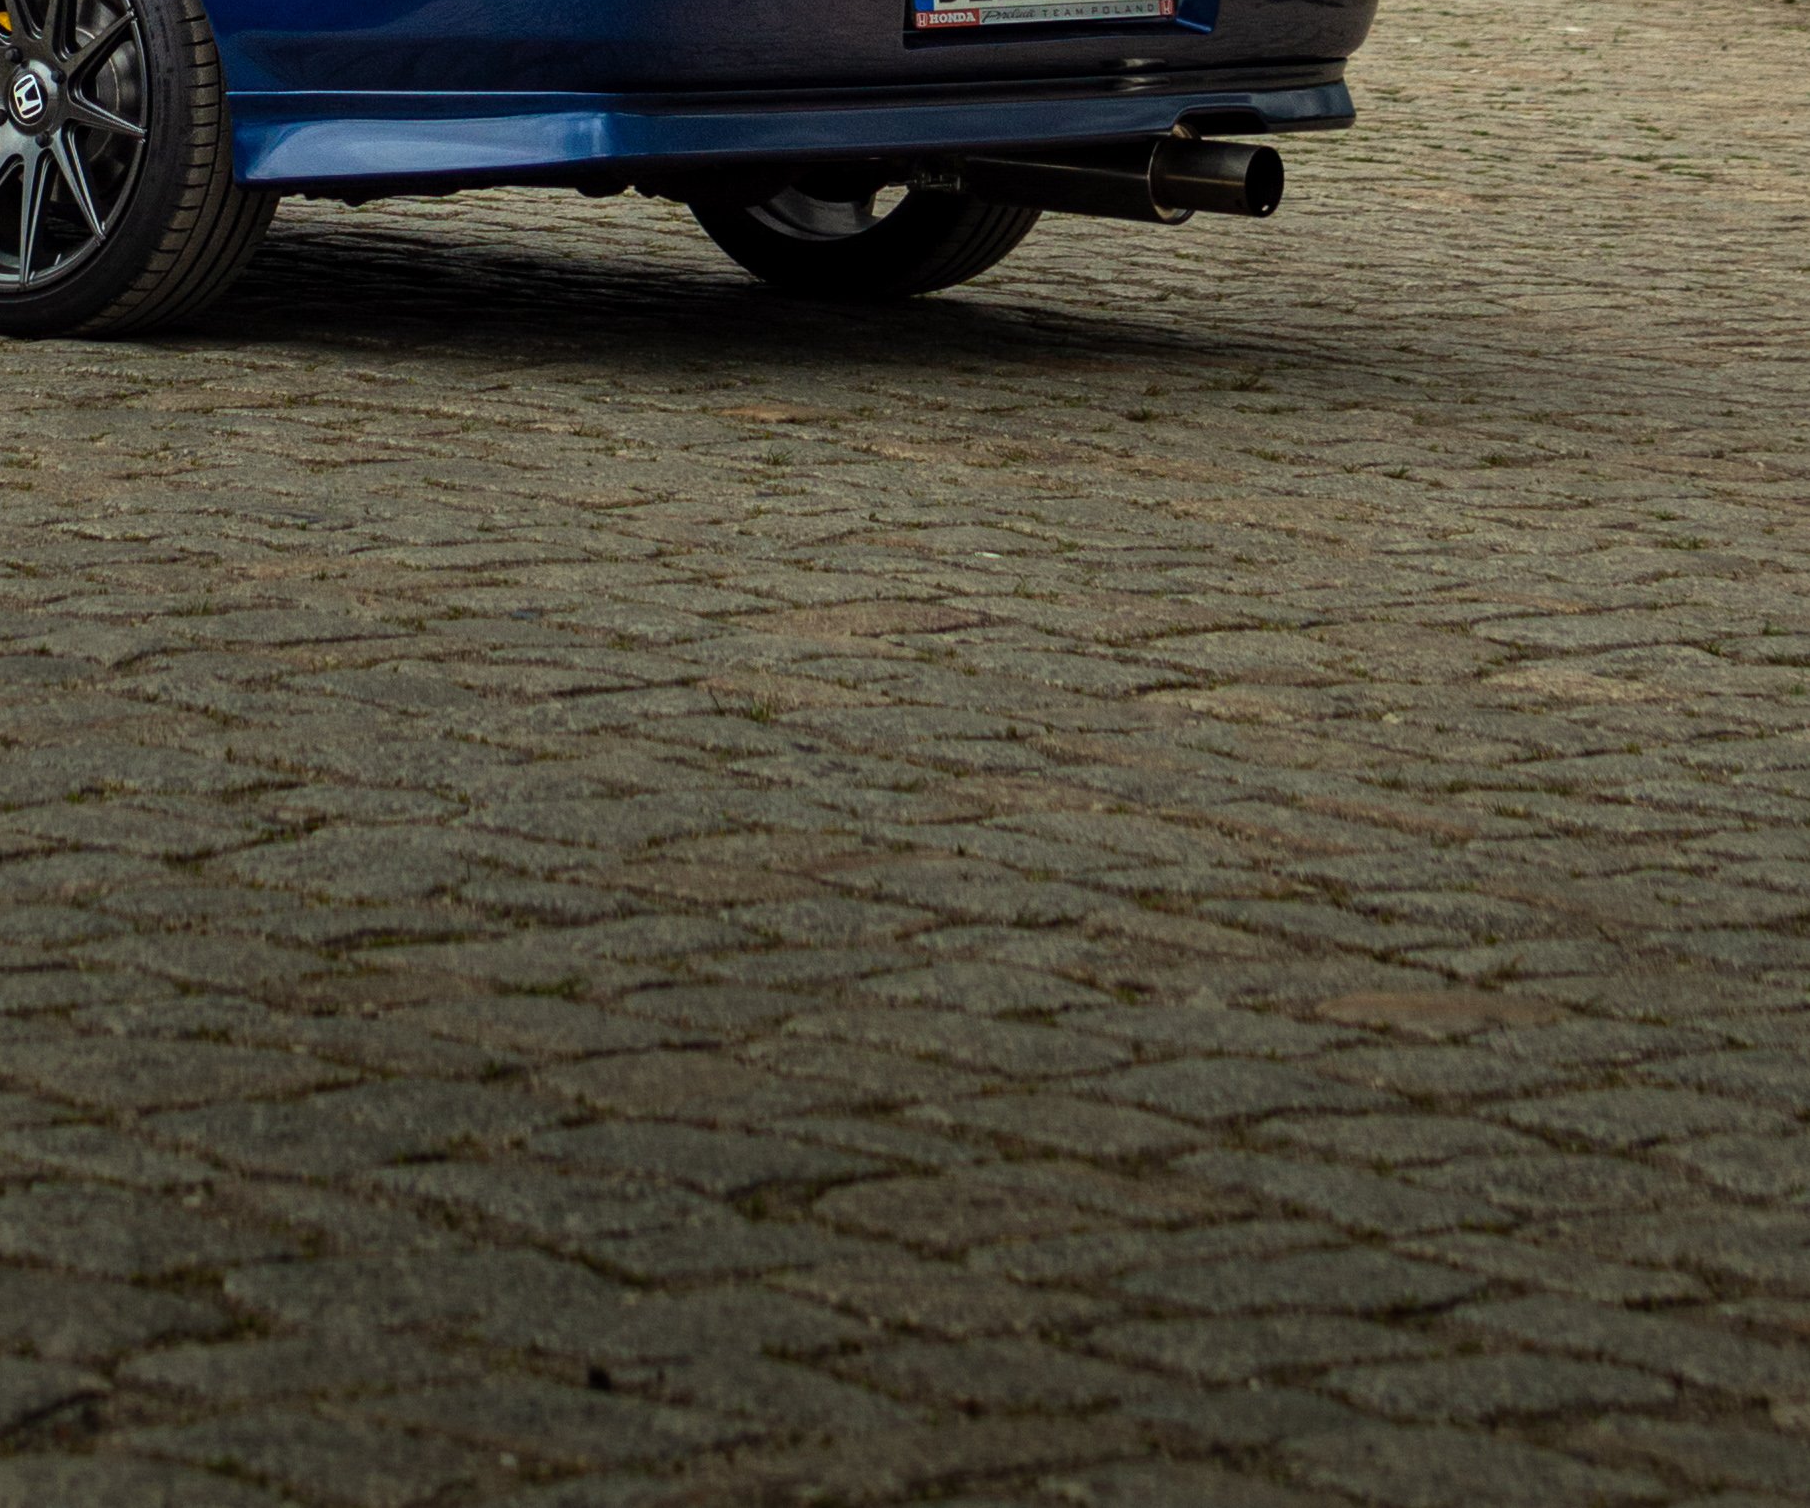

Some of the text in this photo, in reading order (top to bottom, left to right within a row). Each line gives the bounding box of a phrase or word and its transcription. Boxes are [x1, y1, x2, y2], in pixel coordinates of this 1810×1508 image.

[929, 12, 976, 24] HONDA
[1042, 8, 1084, 18] TEAM
[1091, 3, 1155, 15] POLAND
